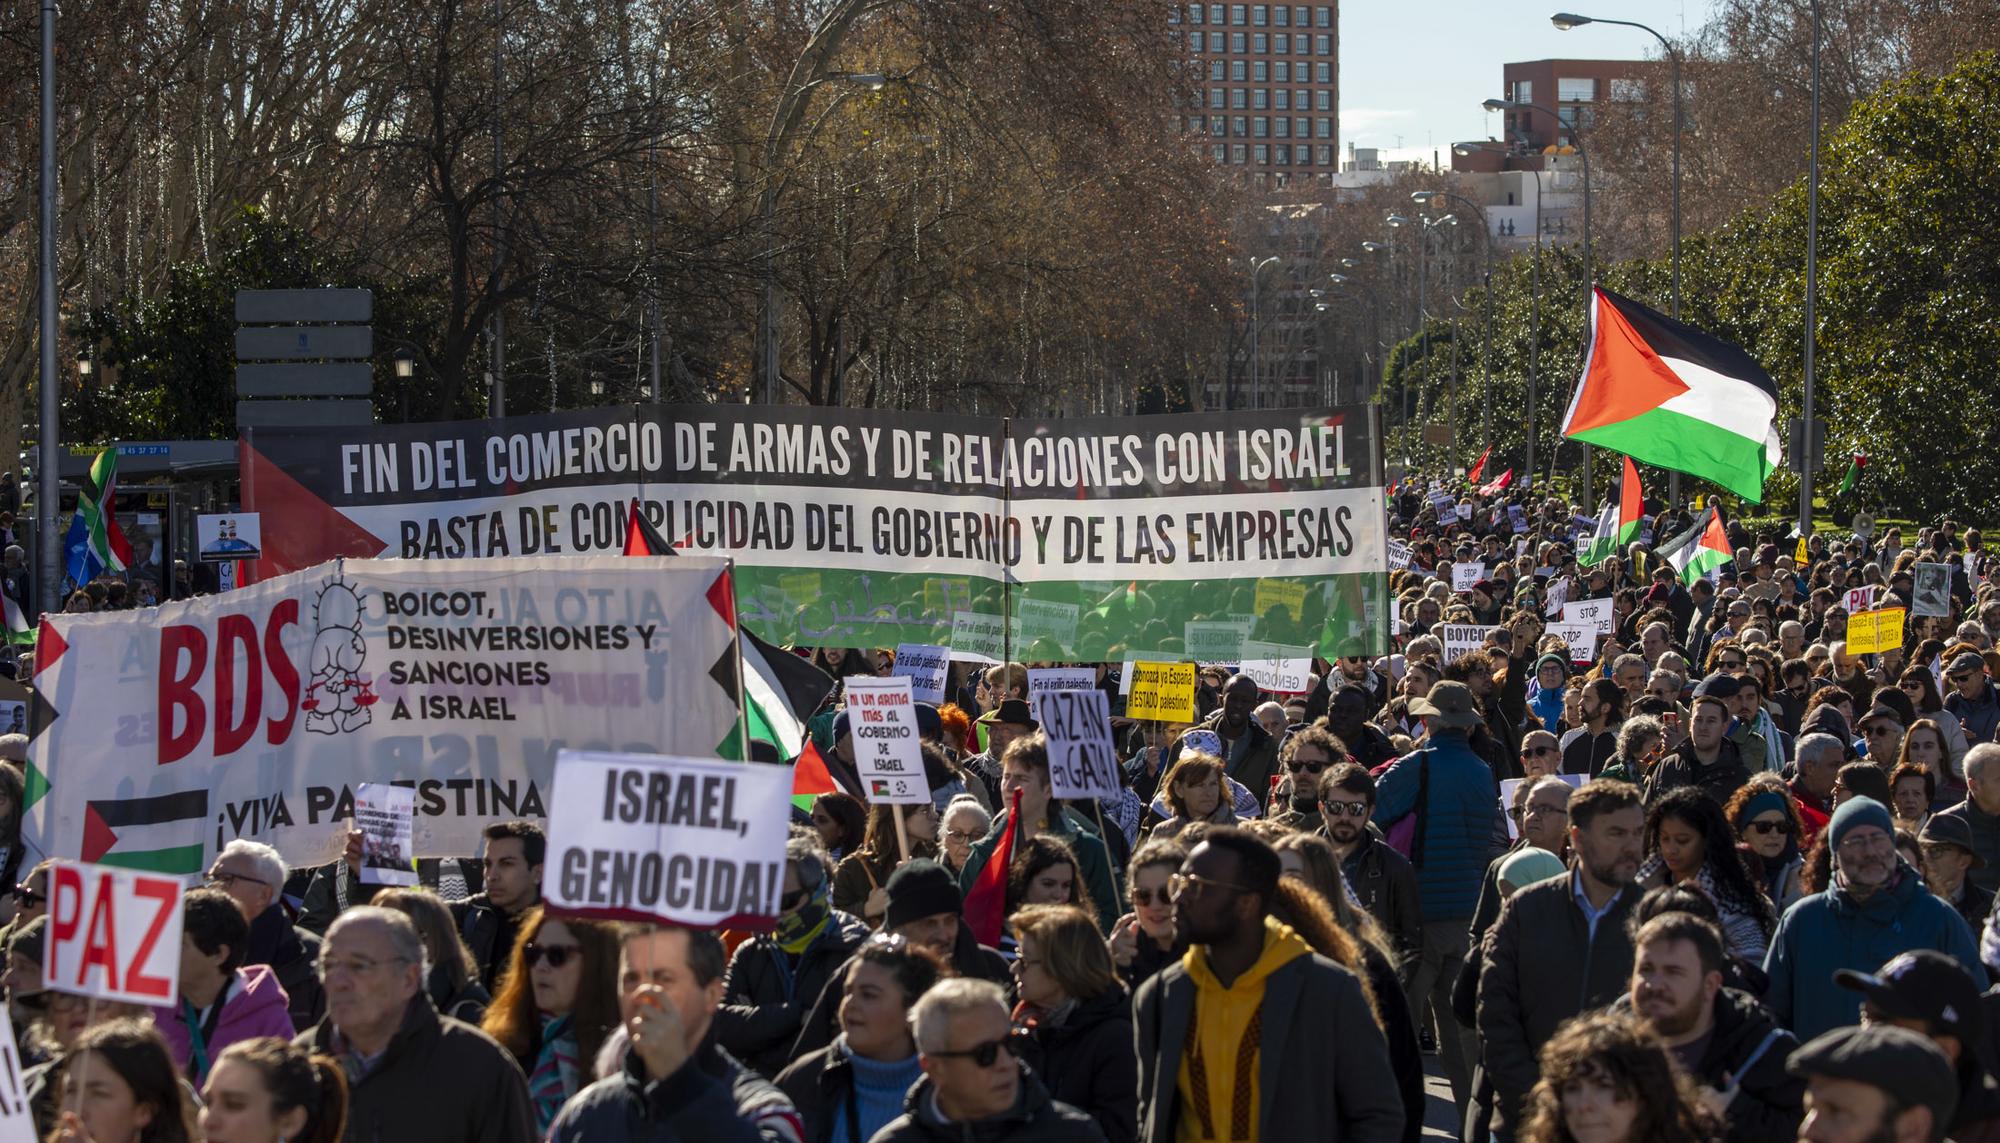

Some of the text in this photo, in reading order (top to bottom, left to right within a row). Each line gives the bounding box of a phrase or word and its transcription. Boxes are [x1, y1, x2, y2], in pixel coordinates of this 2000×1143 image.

[341, 422, 1351, 494] FIN DEL COMERCIO DE ARMAS Y DE RELACIONES CON ISRAEL
[400, 510, 510, 559] BASTA
[519, 504, 561, 555] DE
[806, 503, 863, 553] DEL
[872, 505, 1021, 566] GOBIERNO
[1031, 516, 1052, 564] Y
[1063, 516, 1104, 564] DE
[1116, 513, 1176, 564] LAS
[1186, 505, 1353, 563] EMPRESAS
[1463, 568, 1478, 578] STOP
[383, 591, 494, 619] BOICOT,
[1850, 588, 1871, 612] PA
[1580, 606, 1599, 619] STOP
[387, 624, 656, 651] DESINVERSIONES Y
[1446, 627, 1491, 642] BOYCO
[1561, 631, 1582, 643] STOP
[157, 598, 299, 764] BDS
[389, 661, 550, 686] SANCIONES
[1160, 671, 1168, 688] ya
[1169, 667, 1192, 688] España
[391, 695, 516, 721] A ISRAEL
[850, 692, 909, 706] NI UN ARMA
[1135, 690, 1158, 709] ESTADO
[1159, 692, 1190, 713] palestino!
[887, 710, 900, 722] AL
[1040, 692, 1106, 743] CAZAN
[858, 726, 911, 739] GOBIERNO
[878, 742, 890, 755] DE
[874, 758, 905, 772] ISRAEL
[1052, 764, 1069, 788] en
[603, 769, 749, 839] ISRAEL,
[217, 793, 294, 852] ¡VIVA
[560, 846, 781, 917] GENOCIDA!
[50, 869, 178, 1000] PAZ
